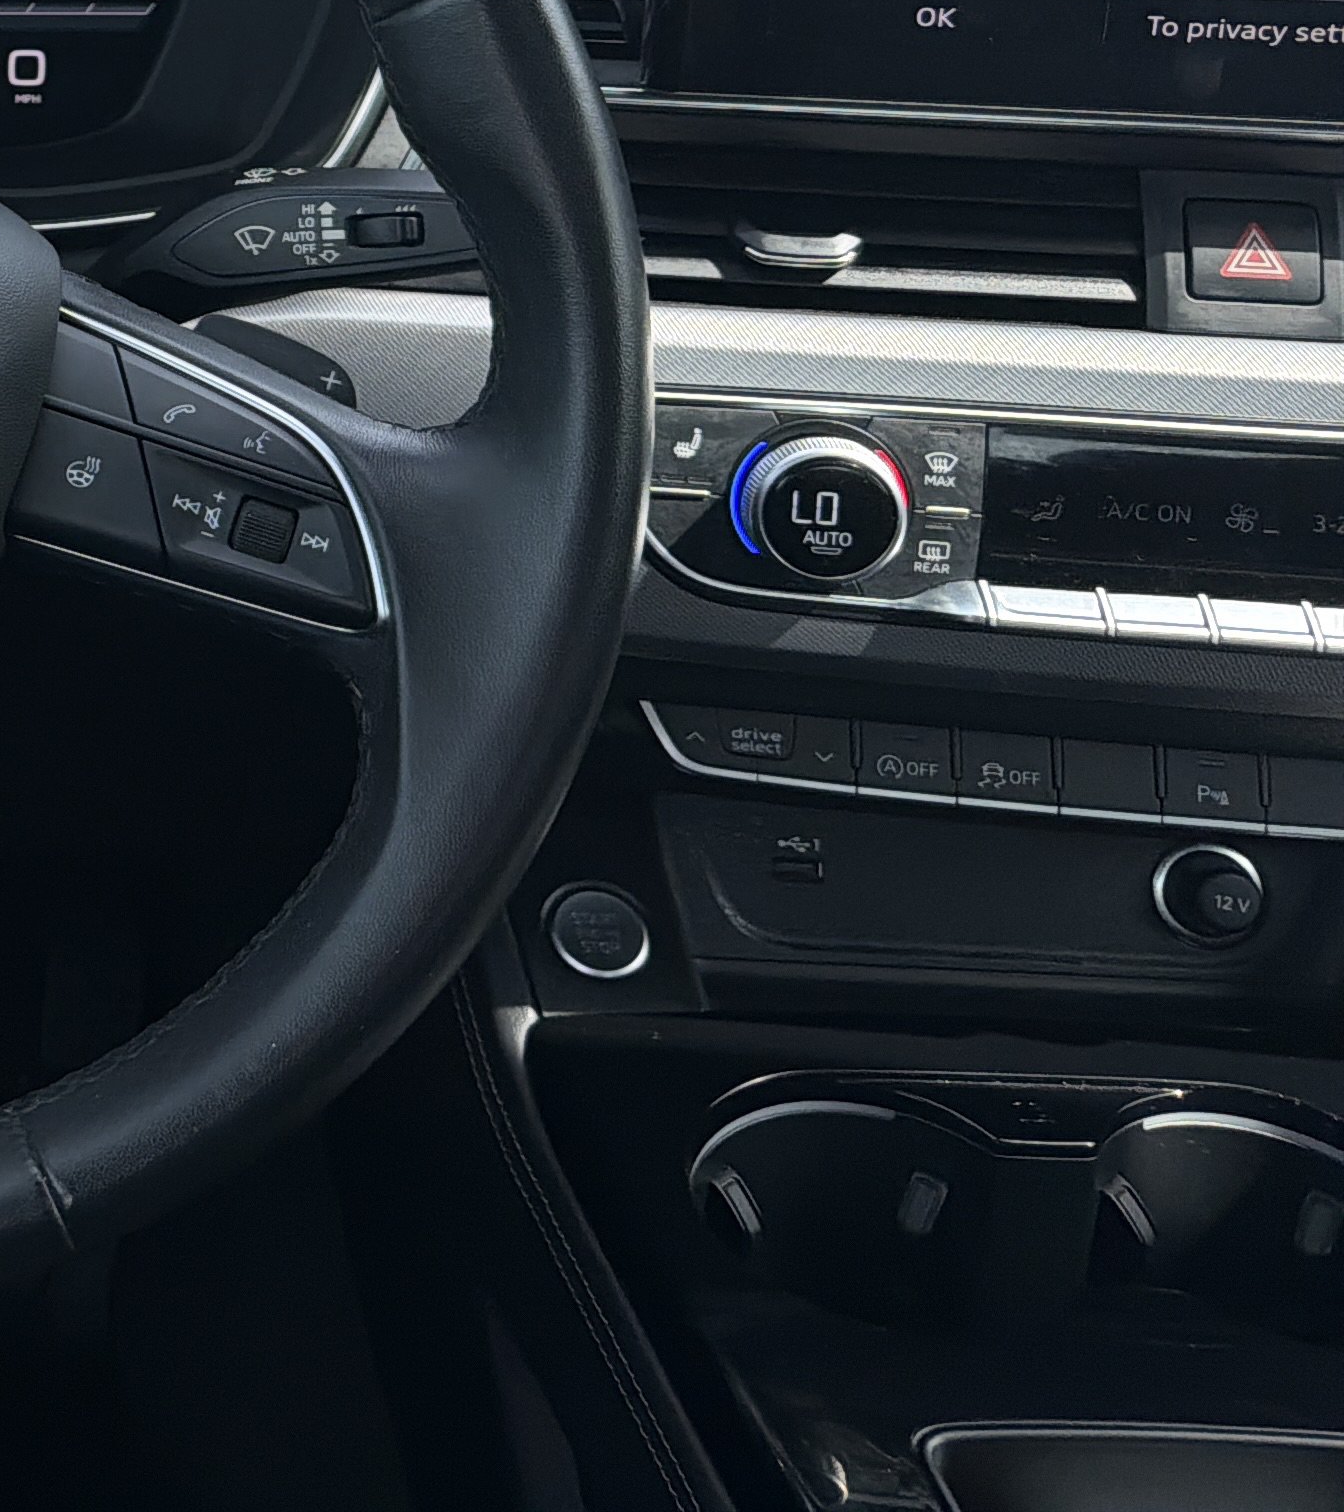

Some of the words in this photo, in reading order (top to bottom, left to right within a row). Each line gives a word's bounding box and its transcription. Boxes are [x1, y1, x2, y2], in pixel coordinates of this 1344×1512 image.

[916, 7, 956, 28] OK
[1148, 16, 1179, 36] To
[1187, 19, 1288, 46] privacy
[15, 94, 41, 104] MPH
[234, 177, 275, 186] FRONT
[302, 204, 316, 214] HI
[298, 218, 315, 228] LO
[282, 231, 315, 242] AUTO
[293, 244, 316, 255] OFF
[304, 256, 318, 266] 1x
[924, 473, 956, 488] MAX
[792, 490, 840, 526] LO
[1108, 503, 1149, 522] A/C
[1158, 504, 1192, 524] ON
[802, 530, 853, 547] AUTO
[913, 560, 951, 575] REAR
[731, 727, 782, 742] drive
[731, 740, 782, 756] select
[906, 762, 939, 777] OFF
[1010, 770, 1041, 785] OFF
[1215, 895, 1233, 911] 12
[1238, 898, 1251, 913] V
